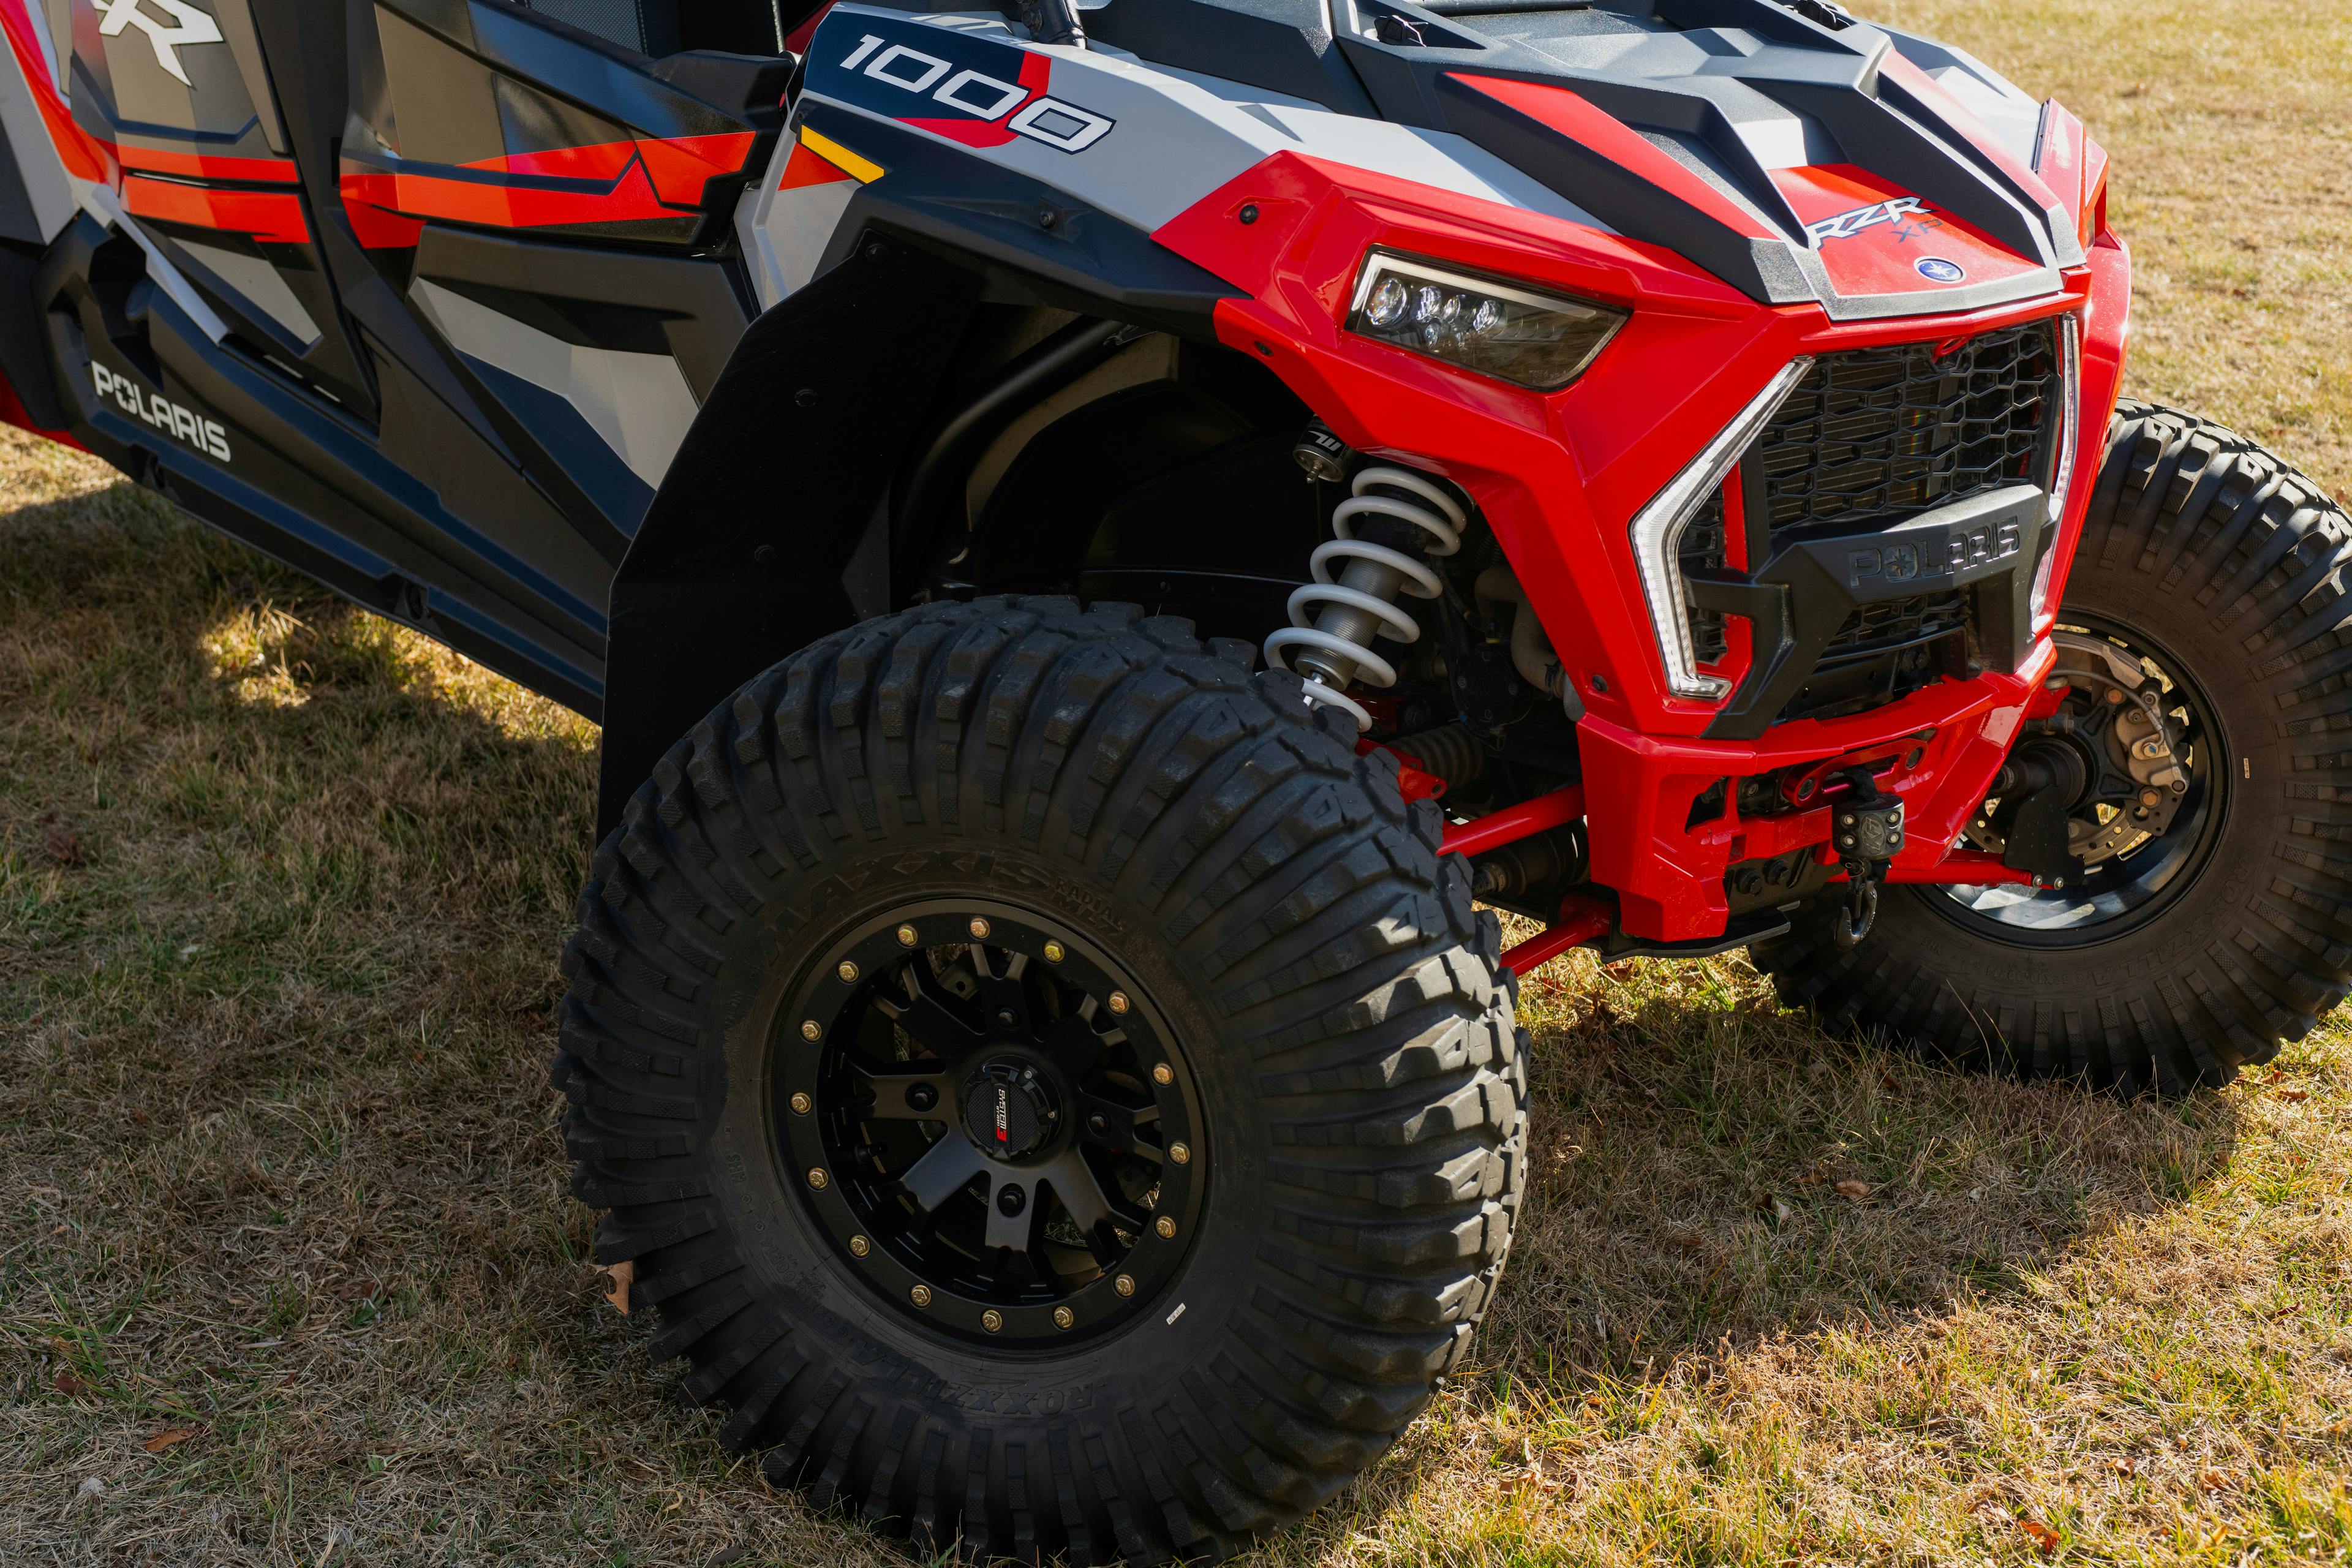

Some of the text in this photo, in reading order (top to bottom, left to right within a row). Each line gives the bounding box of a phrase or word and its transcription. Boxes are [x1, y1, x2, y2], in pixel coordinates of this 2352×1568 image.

[839, 34, 1116, 154] 1000
[1806, 196, 1932, 250] RZR
[1890, 219, 1943, 243] XP
[91, 360, 231, 462] POLARIS
[1849, 516, 2019, 588] POLARIS
[758, 850, 1054, 967] MAXXIS
[1055, 875, 1125, 929] RADIAL
[997, 1127, 1007, 1142] 3
[726, 1154, 746, 1183] NHS
[851, 1337, 1093, 1415] ROXXZILLA
